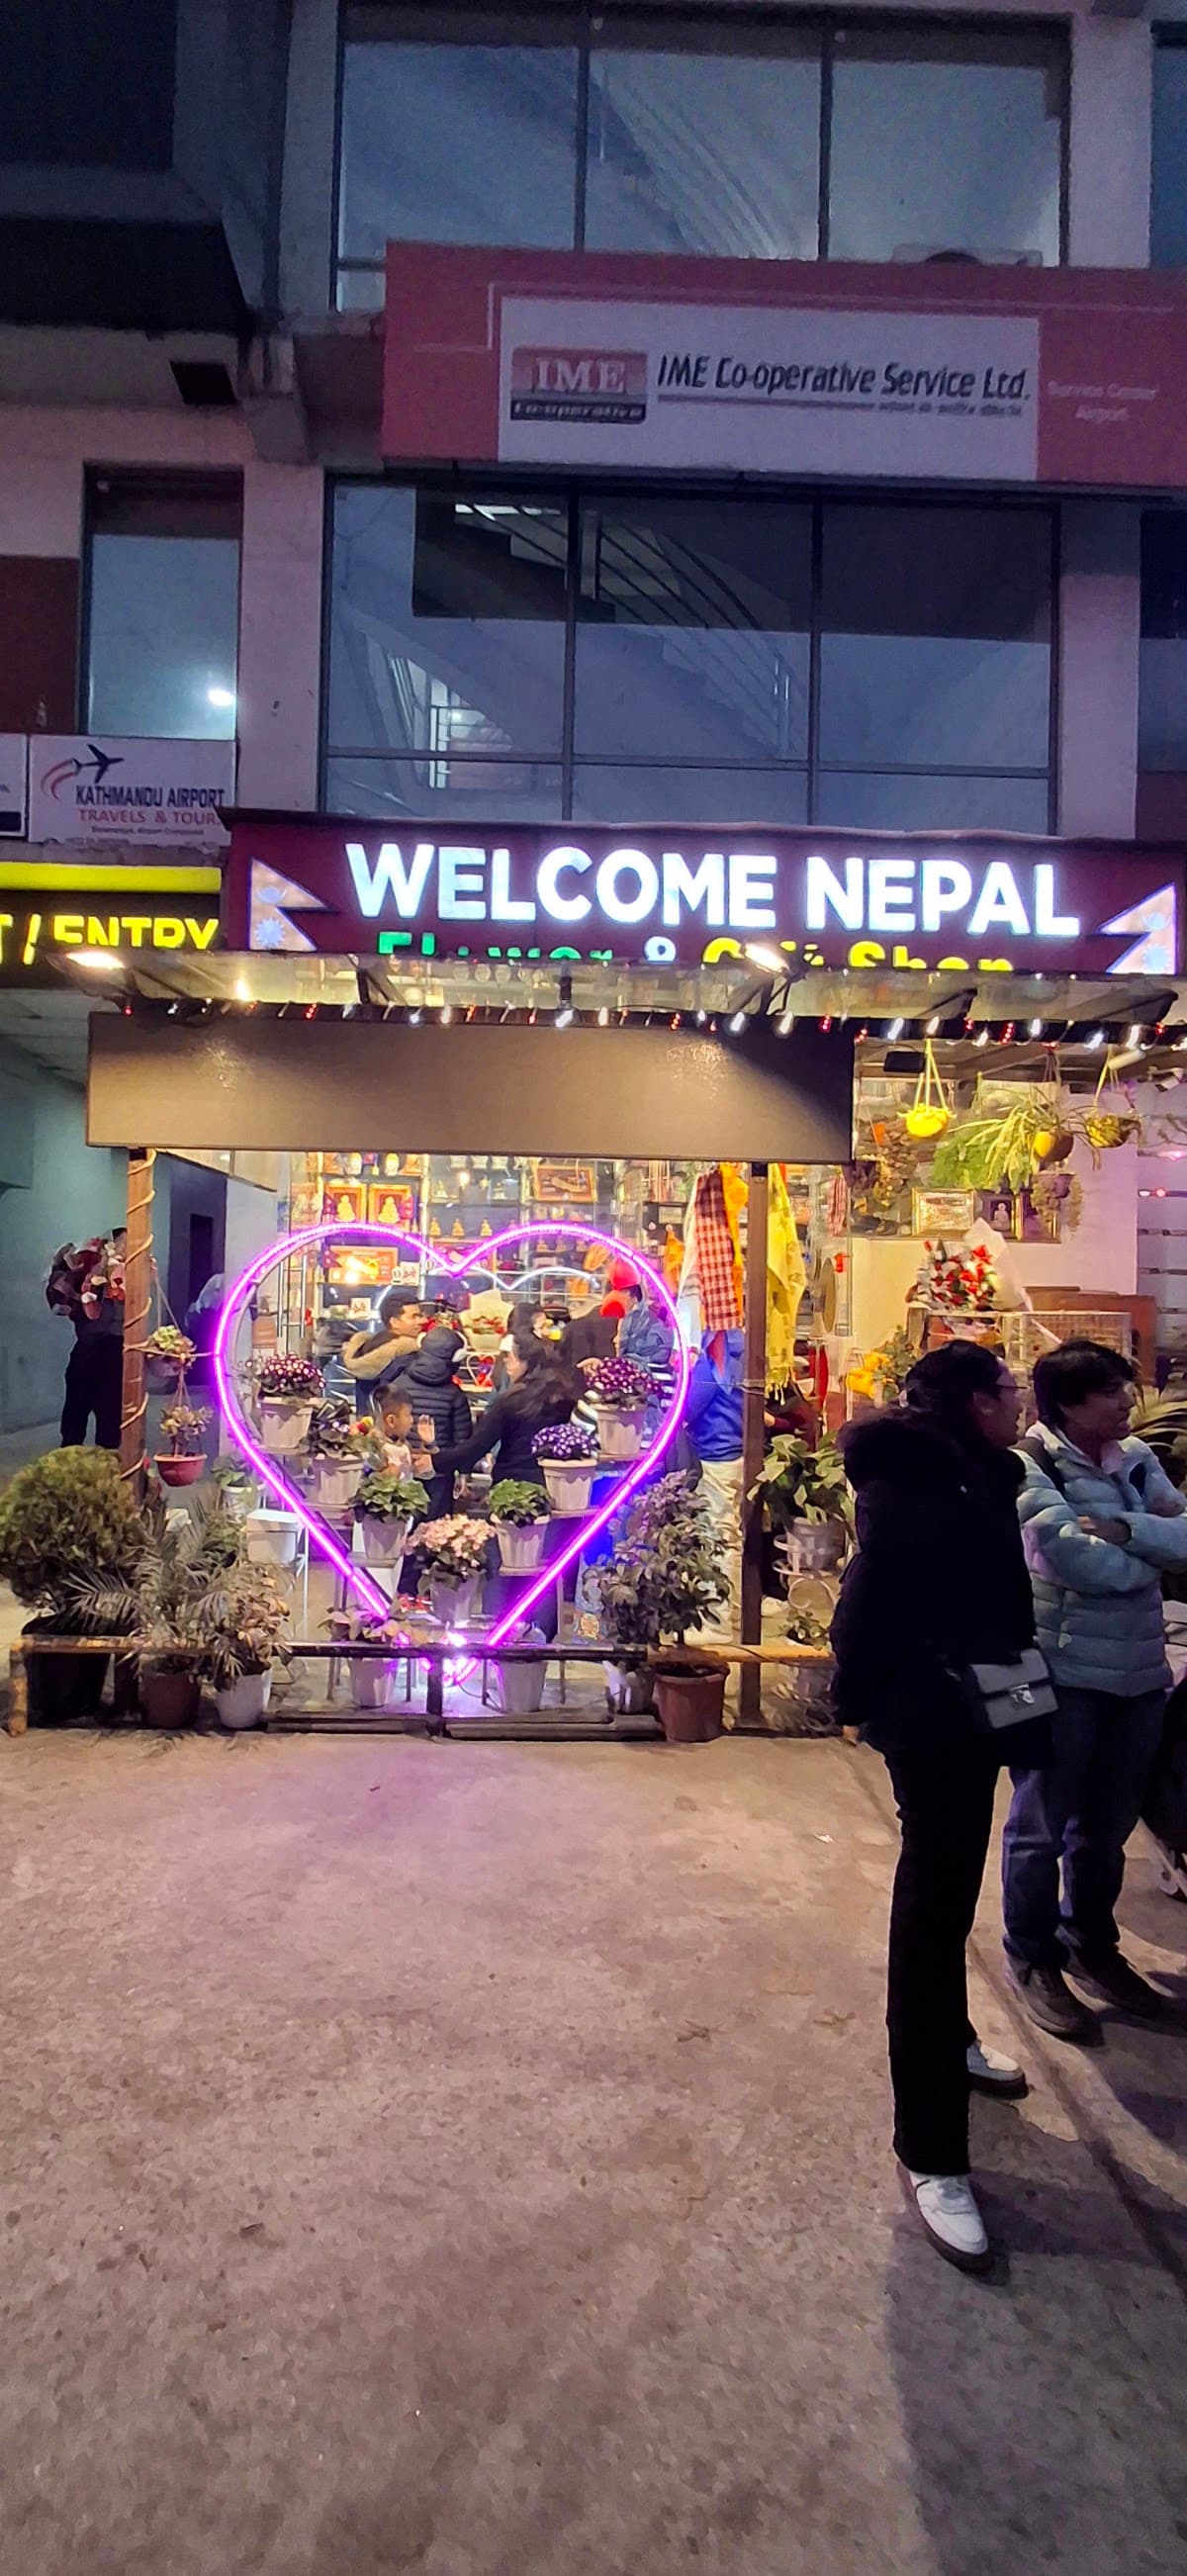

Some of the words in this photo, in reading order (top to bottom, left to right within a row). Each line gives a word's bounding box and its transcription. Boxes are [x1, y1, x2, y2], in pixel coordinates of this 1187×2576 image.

[535, 357, 625, 394] IME
[658, 353, 709, 389] IME
[715, 355, 875, 396] Co-operative
[881, 362, 975, 398] Service
[982, 366, 1030, 400] Ltd.
[75, 784, 163, 807] KATHMANDU
[166, 787, 225, 808] AIRPORT
[79, 809, 146, 824] TRAVELS
[154, 810, 167, 824] &
[173, 811, 221, 826] TOUR
[345, 843, 777, 928] WELCOME
[805, 856, 1080, 937] NEPAL
